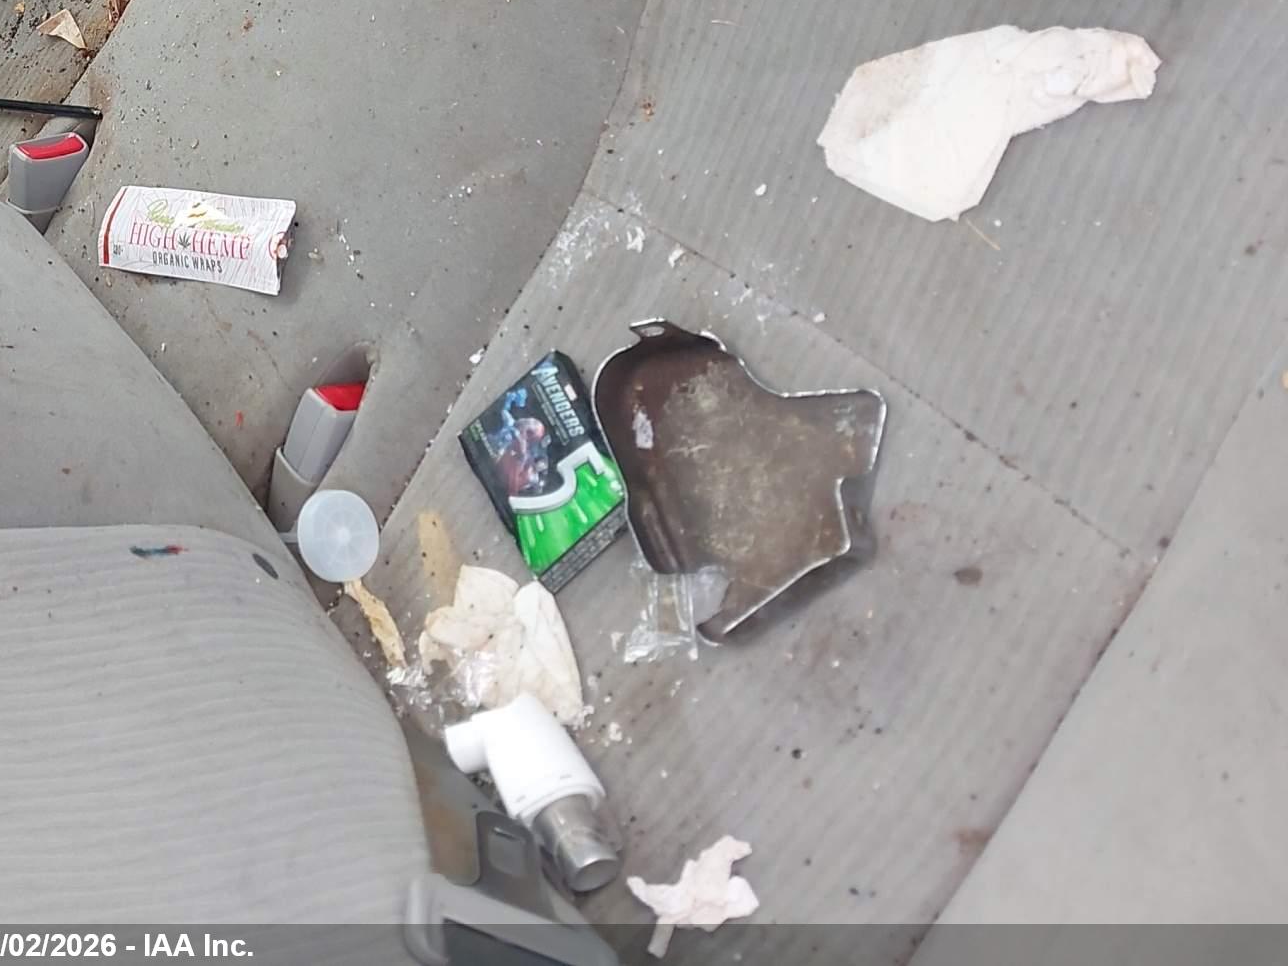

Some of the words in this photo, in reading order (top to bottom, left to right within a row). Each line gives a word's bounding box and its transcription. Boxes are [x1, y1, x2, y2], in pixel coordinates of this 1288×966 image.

[129, 221, 177, 251] HIGH
[191, 230, 253, 260] HEMP
[152, 251, 189, 268] ORGANIC
[191, 257, 223, 274] WRAPS
[531, 365, 584, 437] AVENGERS
[509, 441, 604, 513] 5
